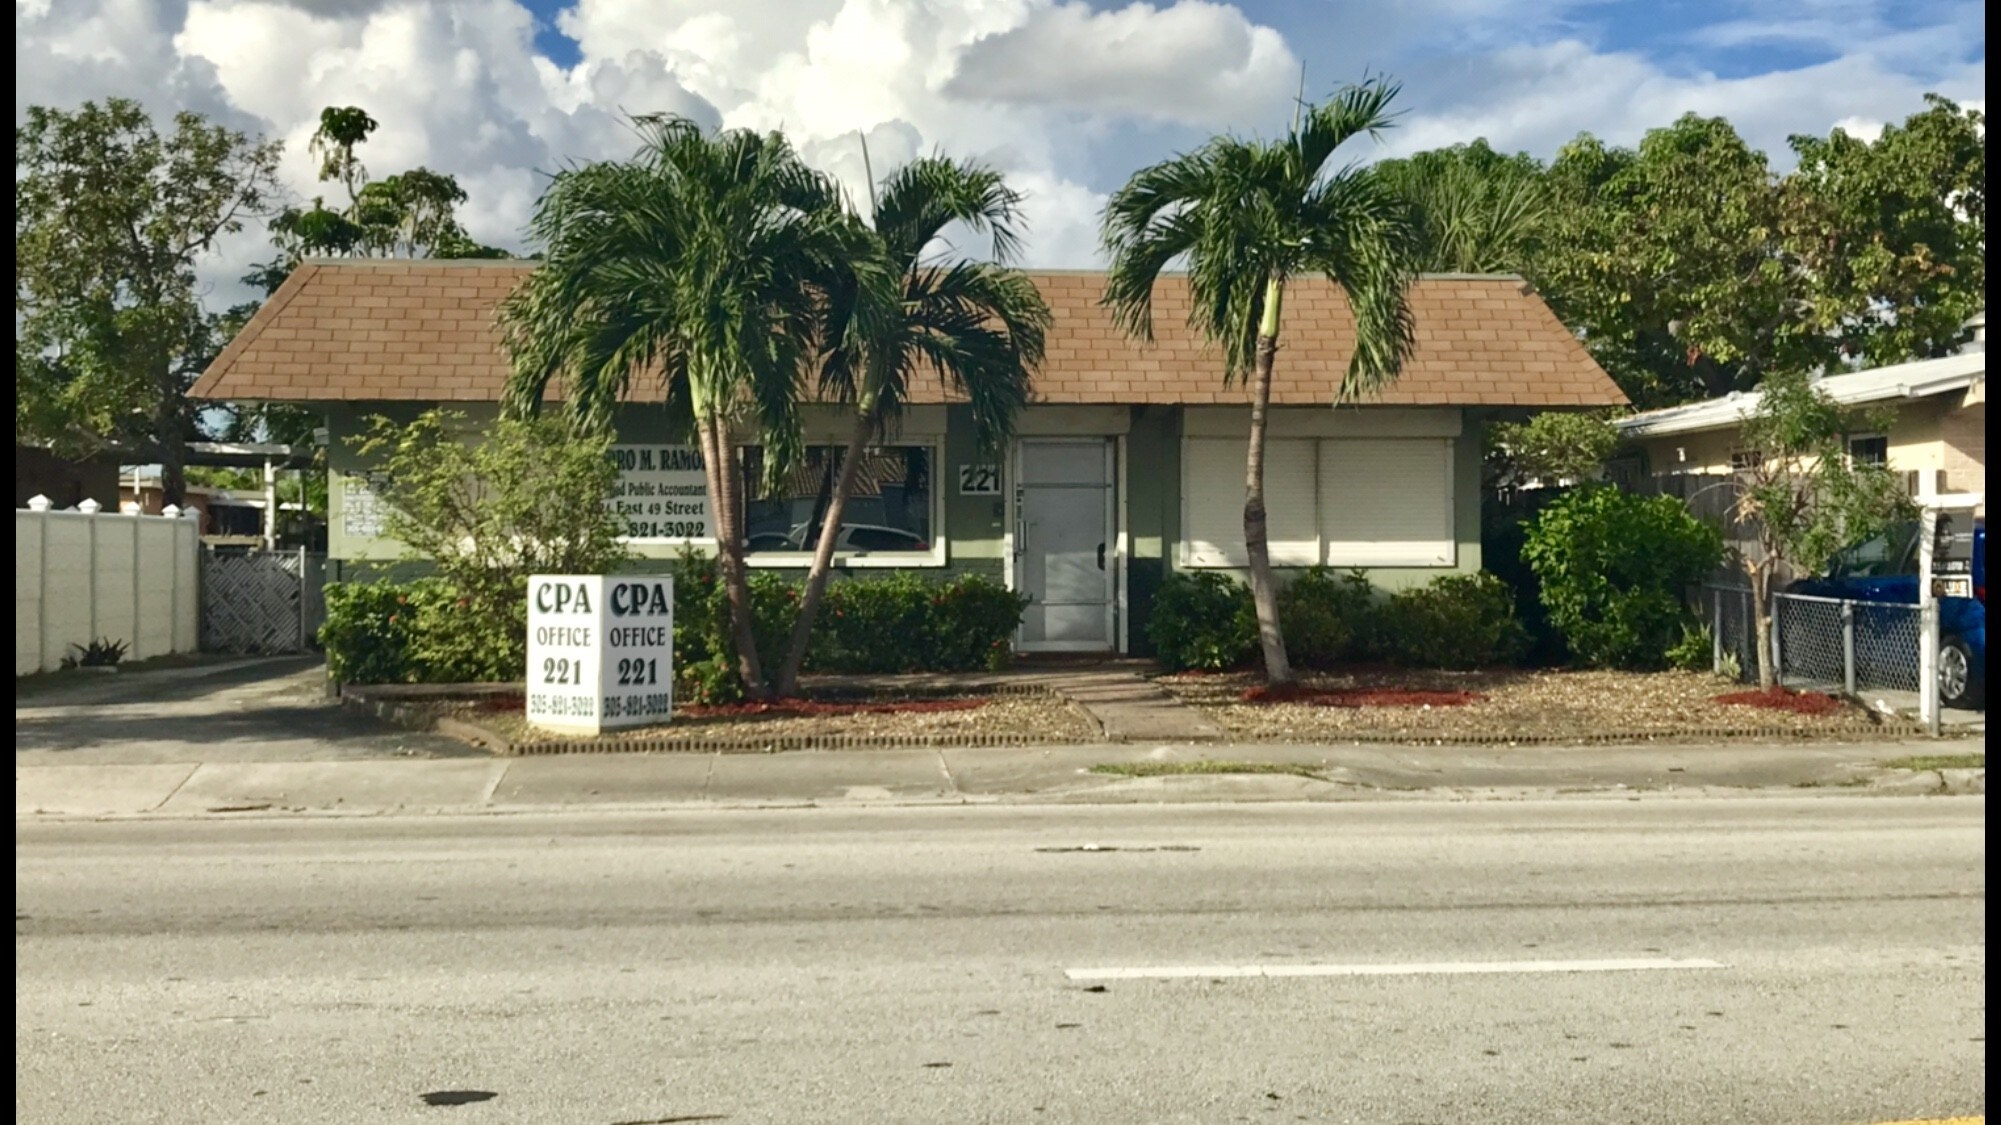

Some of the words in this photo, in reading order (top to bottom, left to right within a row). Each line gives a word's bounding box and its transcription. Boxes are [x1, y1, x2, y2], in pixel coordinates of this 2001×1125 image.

[639, 449, 656, 471] M.
[628, 482, 655, 496] Public
[658, 482, 707, 496] Accountant
[961, 469, 1000, 492] 221
[616, 501, 643, 515] East
[647, 503, 661, 515] 49
[665, 501, 704, 515] Street
[536, 582, 592, 614] CPA
[610, 583, 669, 617] CPA
[536, 626, 591, 647] OFFICE
[610, 627, 665, 647] OFFICE
[543, 657, 581, 685] 221
[617, 658, 656, 686] 221
